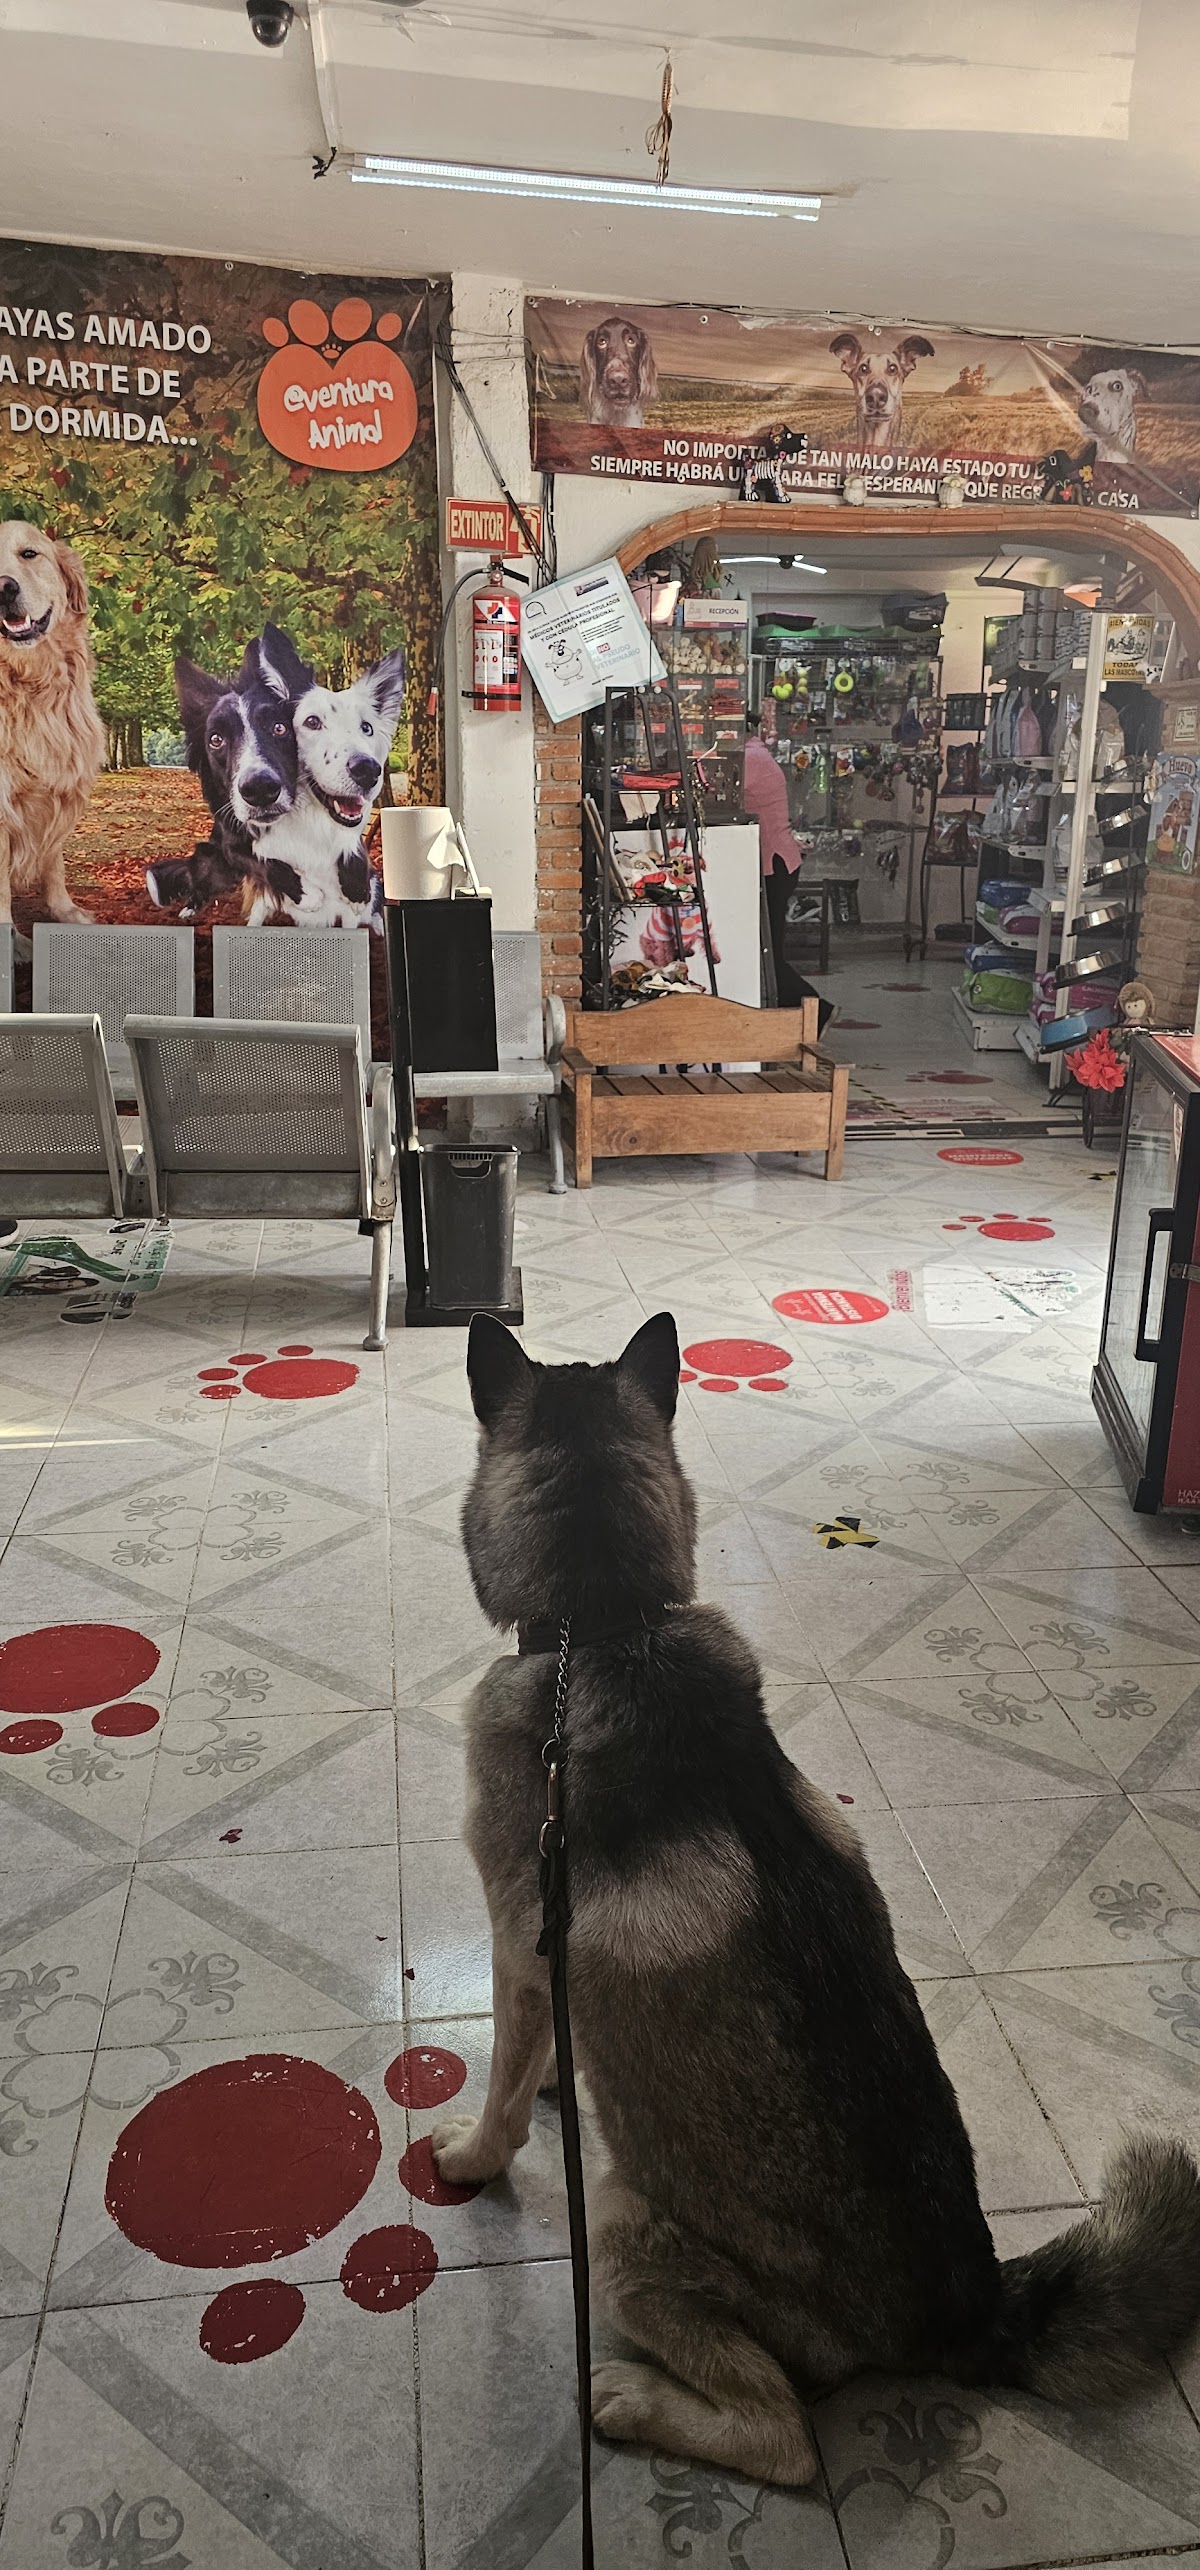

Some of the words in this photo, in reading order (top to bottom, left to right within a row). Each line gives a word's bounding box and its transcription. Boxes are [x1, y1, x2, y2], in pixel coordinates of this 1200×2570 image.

[83, 314, 212, 354] AMADO
[27, 356, 130, 394] PARTE
[137, 366, 181, 399] DE
[9, 402, 198, 446] DORMIDA...
[308, 408, 383, 450] Animal
[663, 439, 690, 457] NO
[781, 450, 807, 466] UE
[810, 449, 842, 468] TAN
[846, 452, 894, 471] MALO
[897, 456, 939, 473] HAYA
[942, 458, 1006, 479] ESTADO
[1009, 463, 1031, 479] TU
[590, 455, 663, 478] SIEMPRE
[666, 461, 725, 482] HABRÁ
[780, 469, 814, 488] ARA
[816, 472, 845, 490] FEL
[864, 475, 941, 495] ESPERAN
[964, 481, 998, 499] QUE
[1097, 491, 1140, 509] CASA
[451, 509, 504, 542] EXTINTOR
[529, 626, 554, 640] MÉDICOS
[553, 610, 591, 629] VETERINARIOS
[591, 597, 620, 612] TITULADOS
[709, 607, 739, 615] RECEPCIÓN
[545, 632, 557, 641] CON
[598, 643, 610, 653] NO
[602, 643, 631, 659] PSEUDO
[595, 647, 641, 670] VETERINARIO
